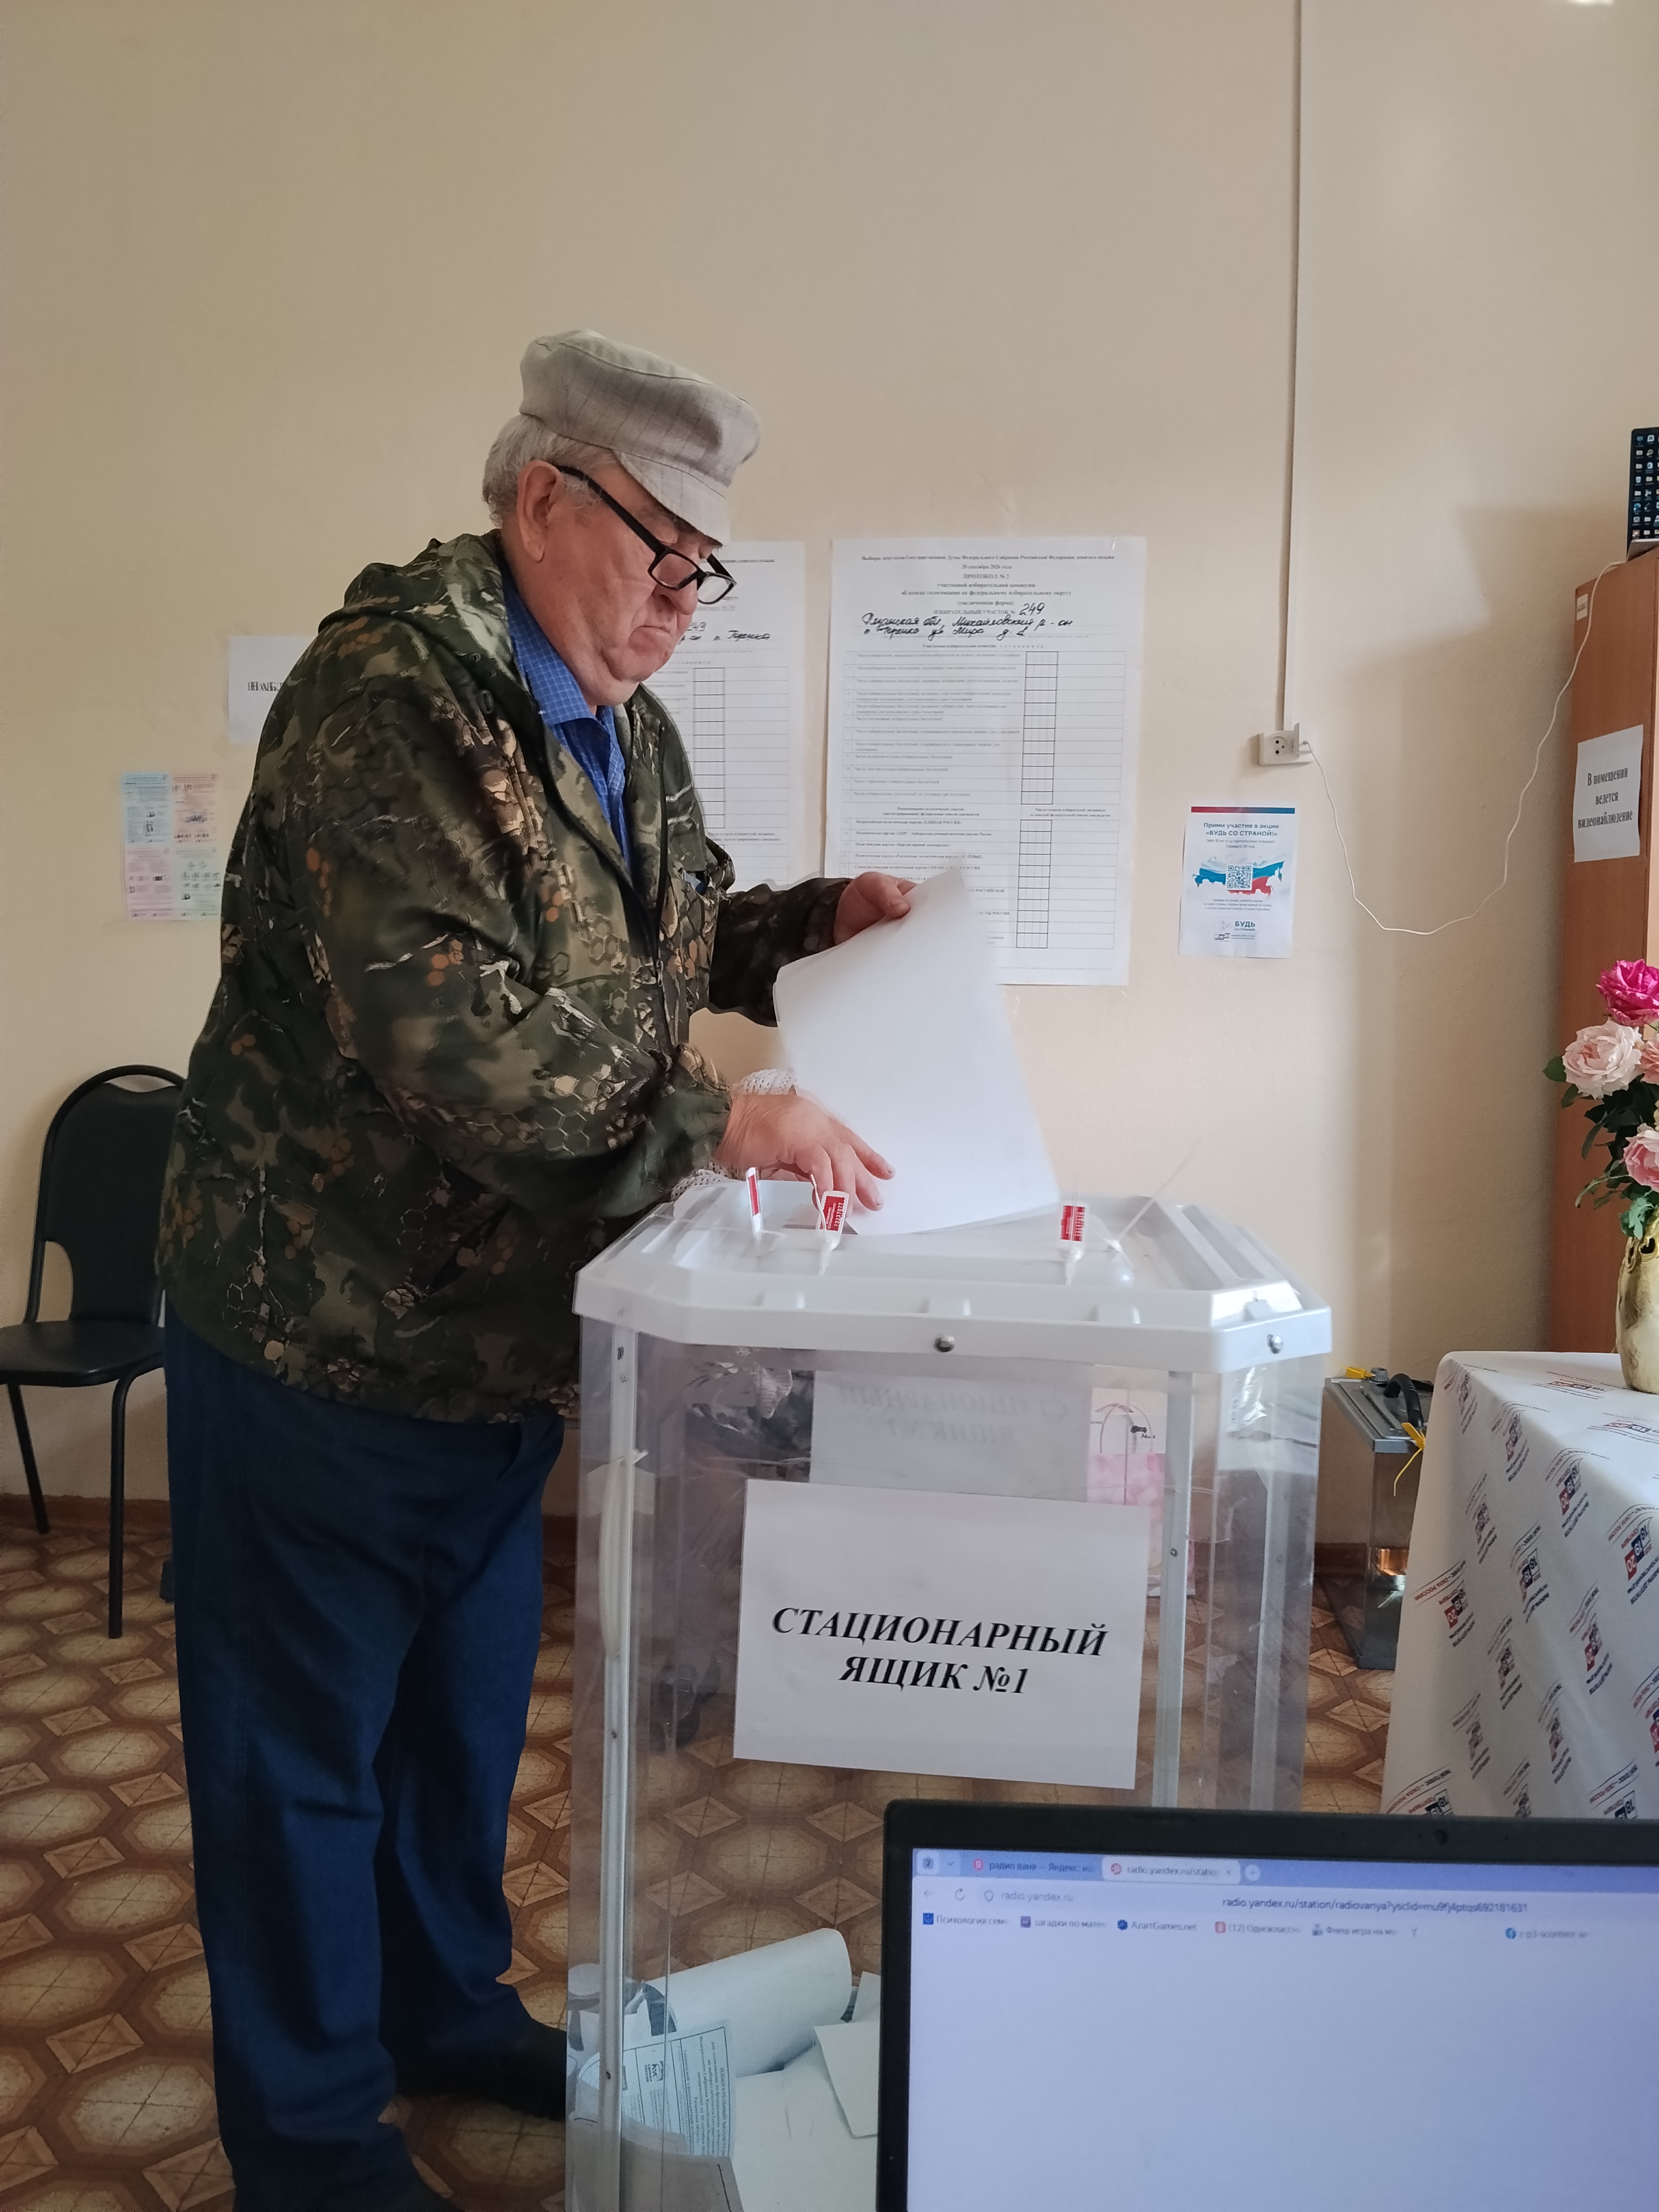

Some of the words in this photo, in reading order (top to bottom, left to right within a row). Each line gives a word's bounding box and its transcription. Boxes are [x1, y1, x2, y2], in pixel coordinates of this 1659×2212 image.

[1019, 602, 1046, 616] 249
[1587, 773, 1593, 786] В
[1593, 767, 1628, 785] помещении
[1595, 791, 1619, 806] ведется
[1577, 811, 1633, 829] видеонаблюдение
[1627, 1555, 1635, 1573] 20
[771, 1607, 1109, 1656] СТАЦИОНАРНЫЙ
[838, 1655, 968, 1692] ЯЩИК
[973, 1665, 1029, 1695] №1
[1438, 1796, 1449, 1808] 18
[1625, 1799, 1635, 1815] 18
[989, 1863, 1015, 1871] радио
[1001, 1891, 1073, 1903] radio.yandex.ru
[936, 1915, 987, 1925] Психология
[1131, 1921, 1197, 1931] AzartGames.net
